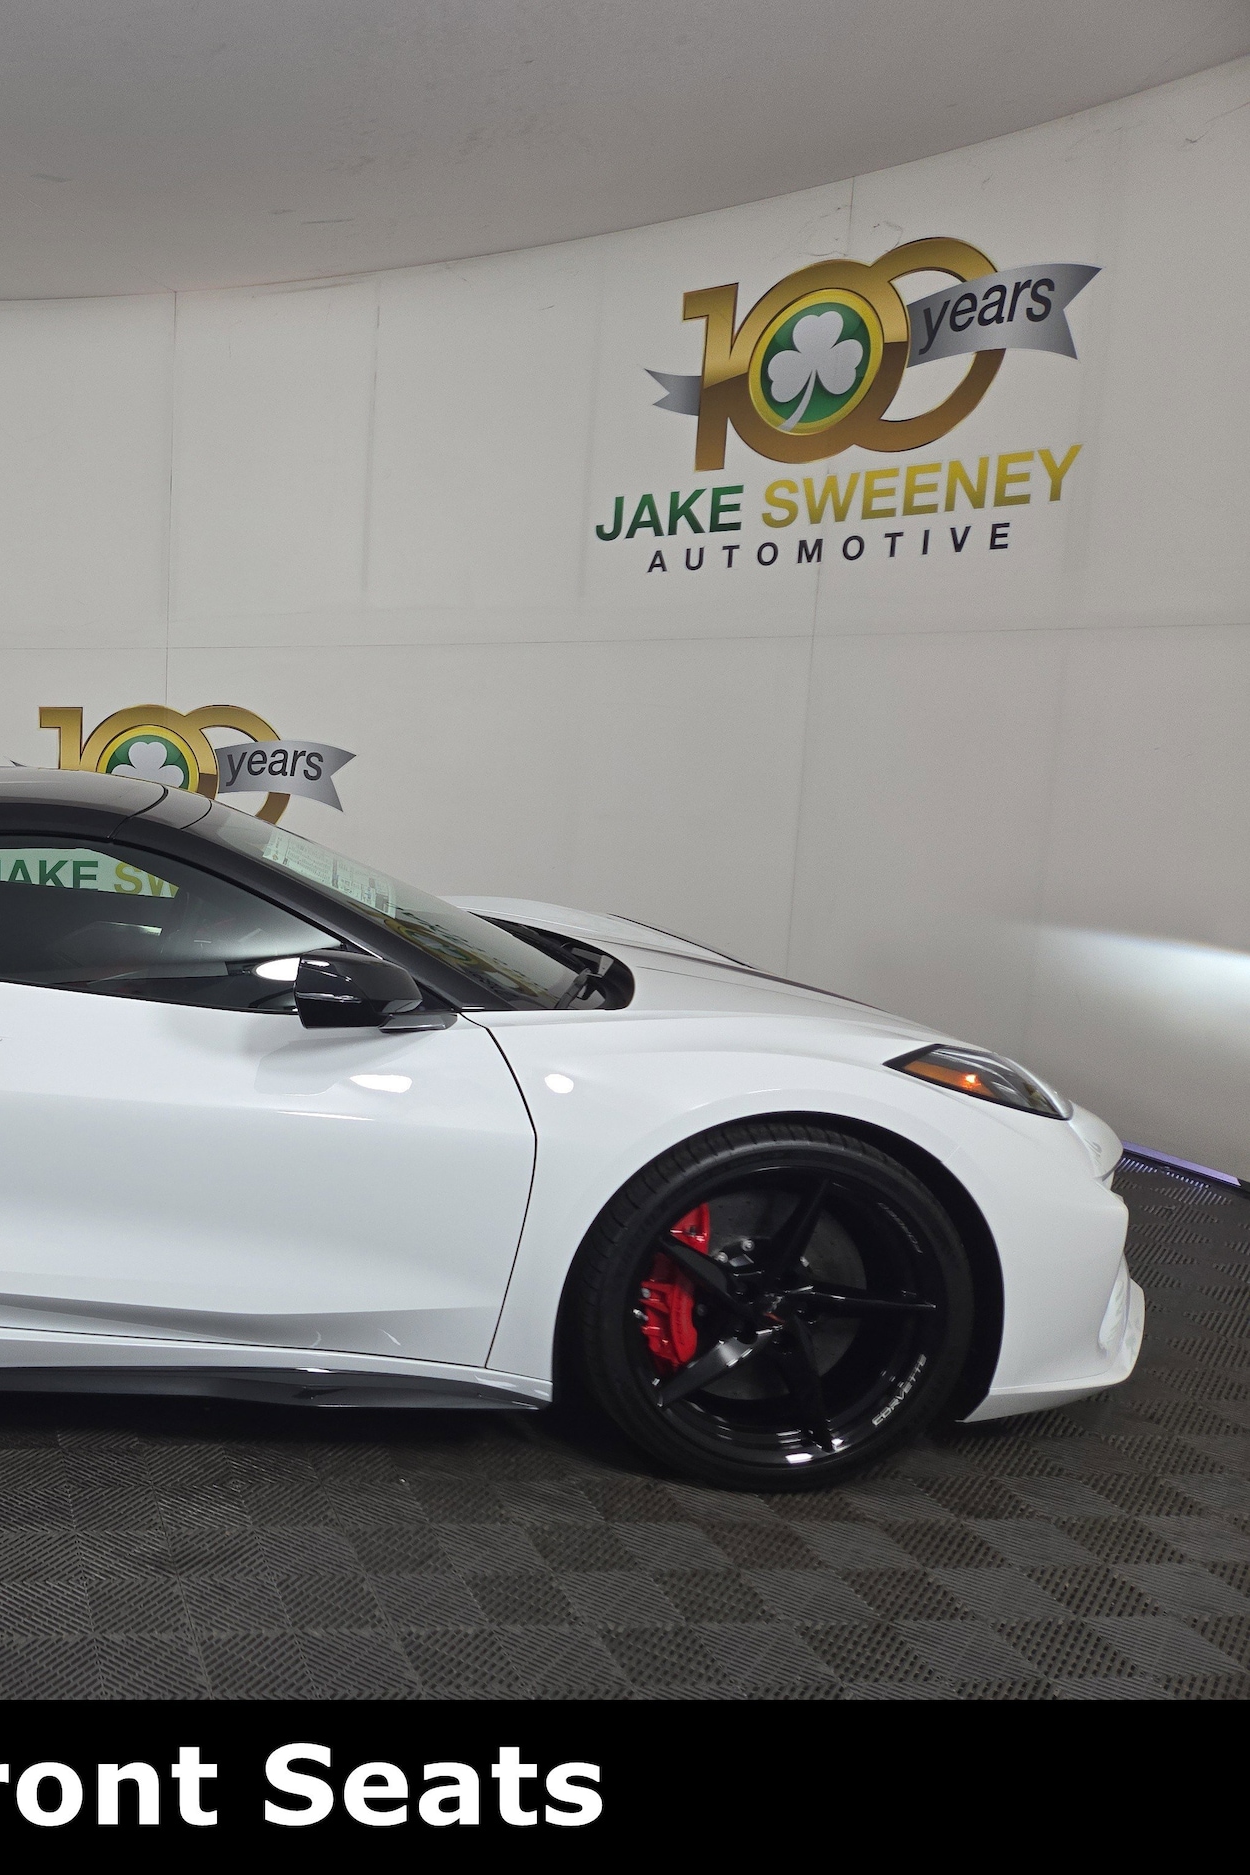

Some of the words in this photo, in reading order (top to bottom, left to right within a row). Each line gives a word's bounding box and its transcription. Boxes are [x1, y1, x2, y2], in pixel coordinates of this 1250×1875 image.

[682, 237, 1007, 472] 100
[918, 276, 1056, 355] years
[595, 484, 744, 541] JAKE
[761, 443, 1084, 529] SWEENEY
[647, 522, 1011, 574] AUTOMOTIVE
[224, 747, 324, 786] years
[871, 1353, 927, 1427] CORVETTE
